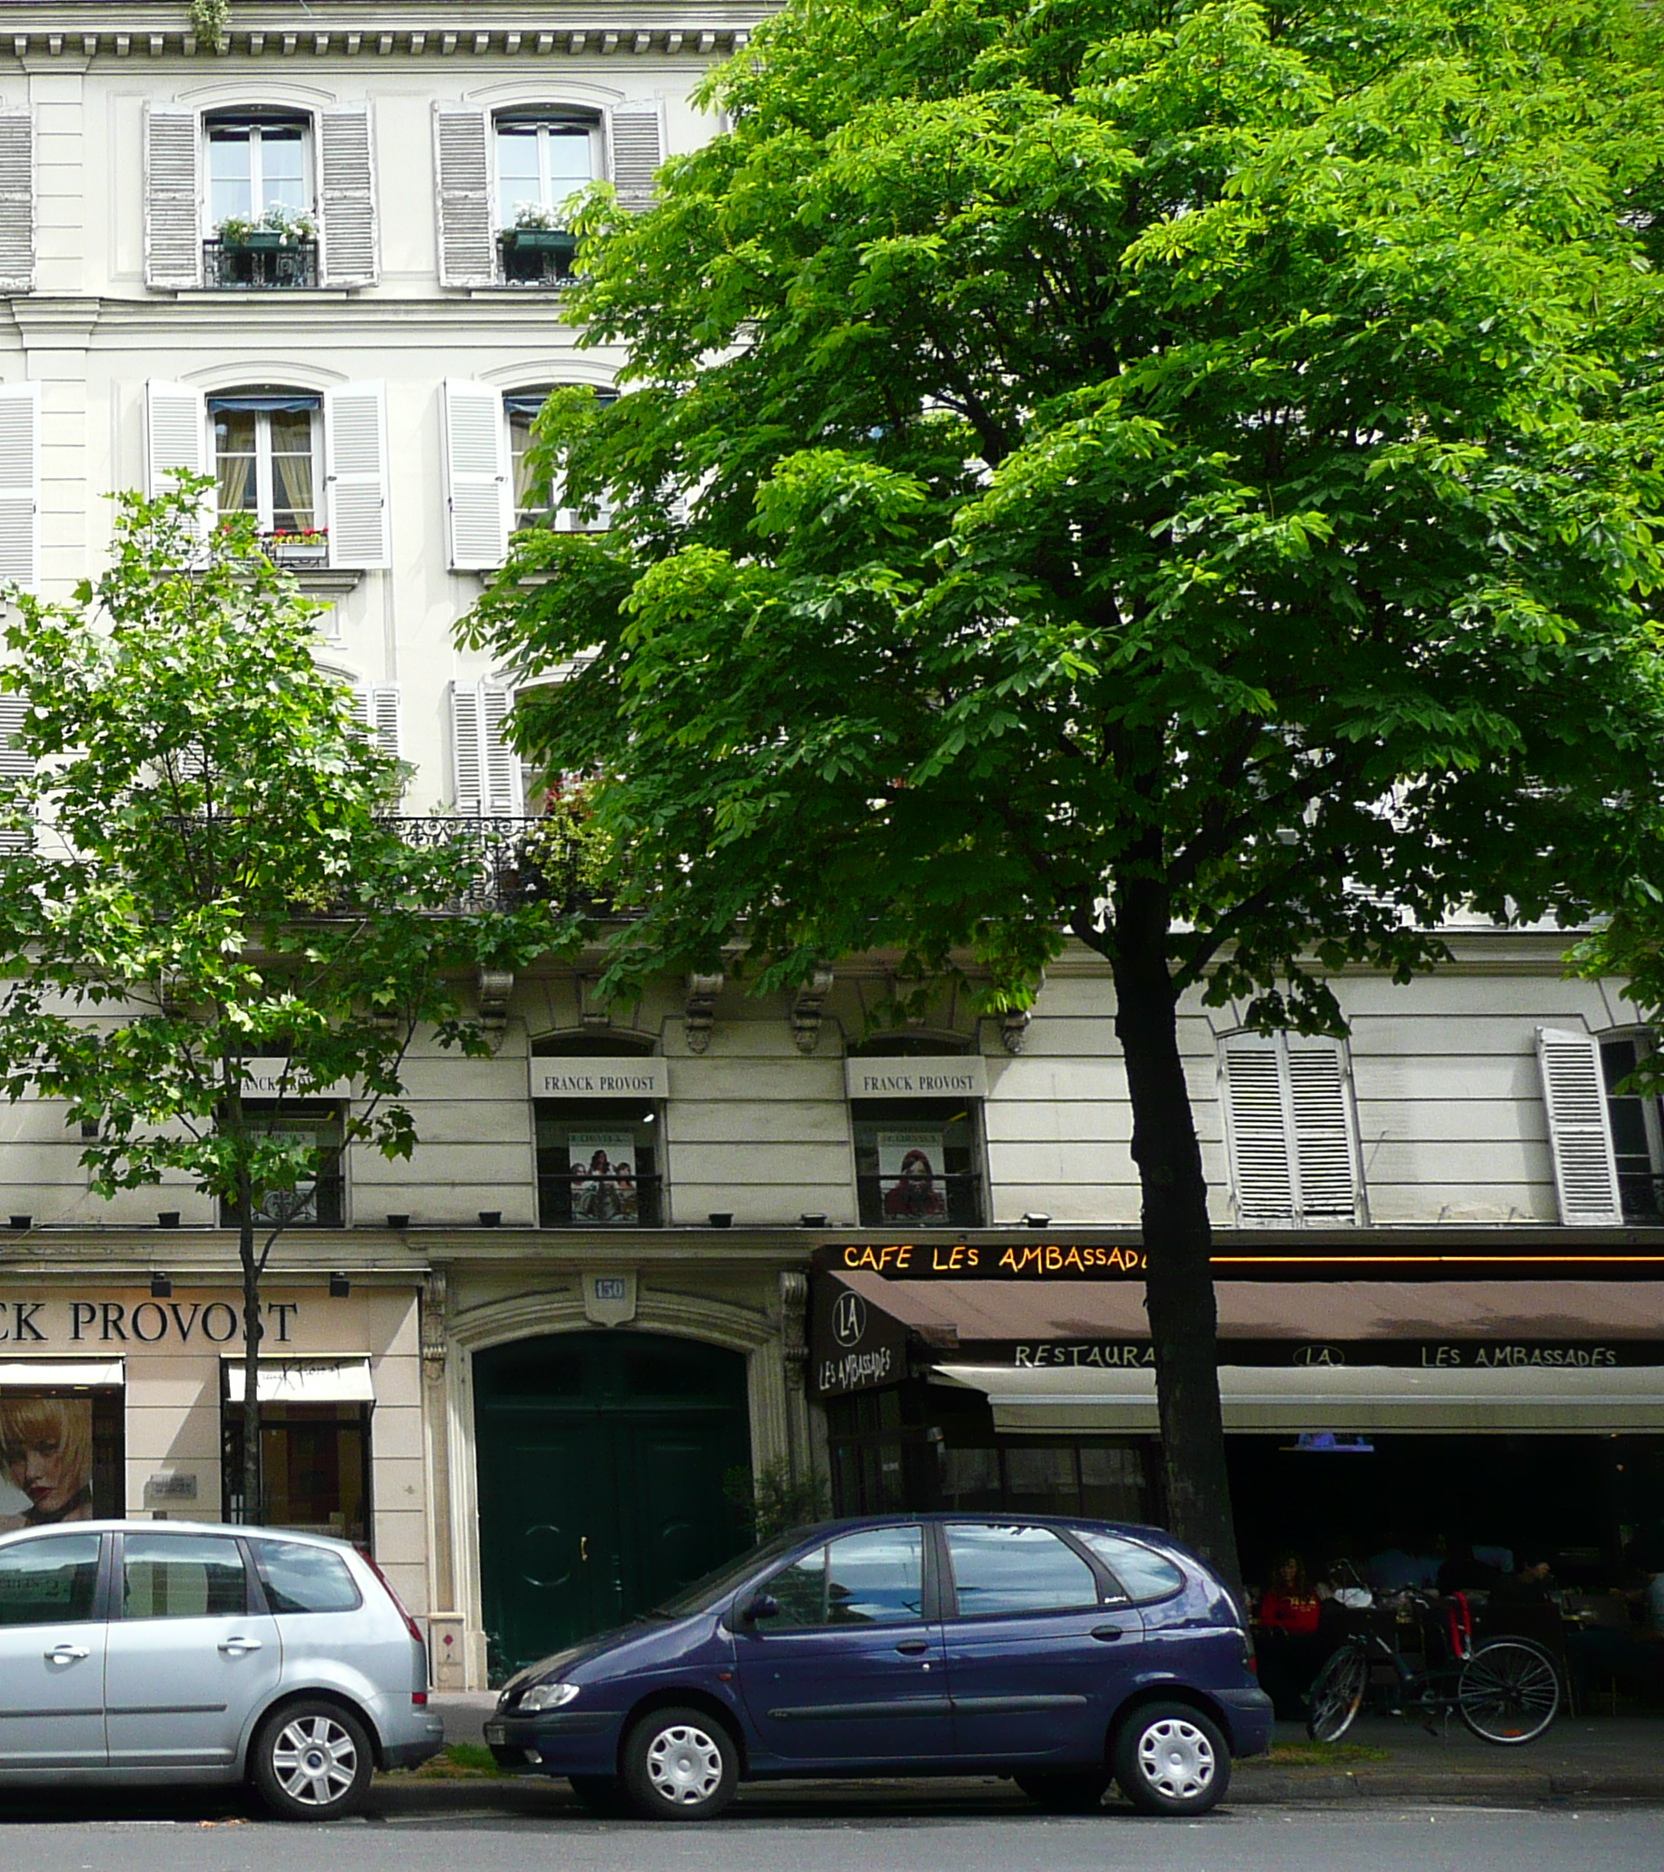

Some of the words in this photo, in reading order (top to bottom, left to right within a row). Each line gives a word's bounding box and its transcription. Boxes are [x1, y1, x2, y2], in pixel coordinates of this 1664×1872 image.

[544, 1076, 594, 1091] FRANCK
[599, 1075, 655, 1091] PROVOST
[863, 1076, 913, 1091] FRANCK
[919, 1075, 975, 1091] PROVOST
[844, 1246, 914, 1270] CAFE
[932, 1247, 979, 1271] LES
[998, 1246, 1150, 1273] AMBASSAD
[839, 1298, 860, 1339] LA
[1015, 1344, 1156, 1367] RESTAURA
[1306, 1348, 1331, 1366] LA
[1421, 1346, 1461, 1367] LES
[1475, 1346, 1616, 1367] AMBASSADES
[819, 1360, 837, 1390] LES
[838, 1347, 892, 1390] AMBASSADES
